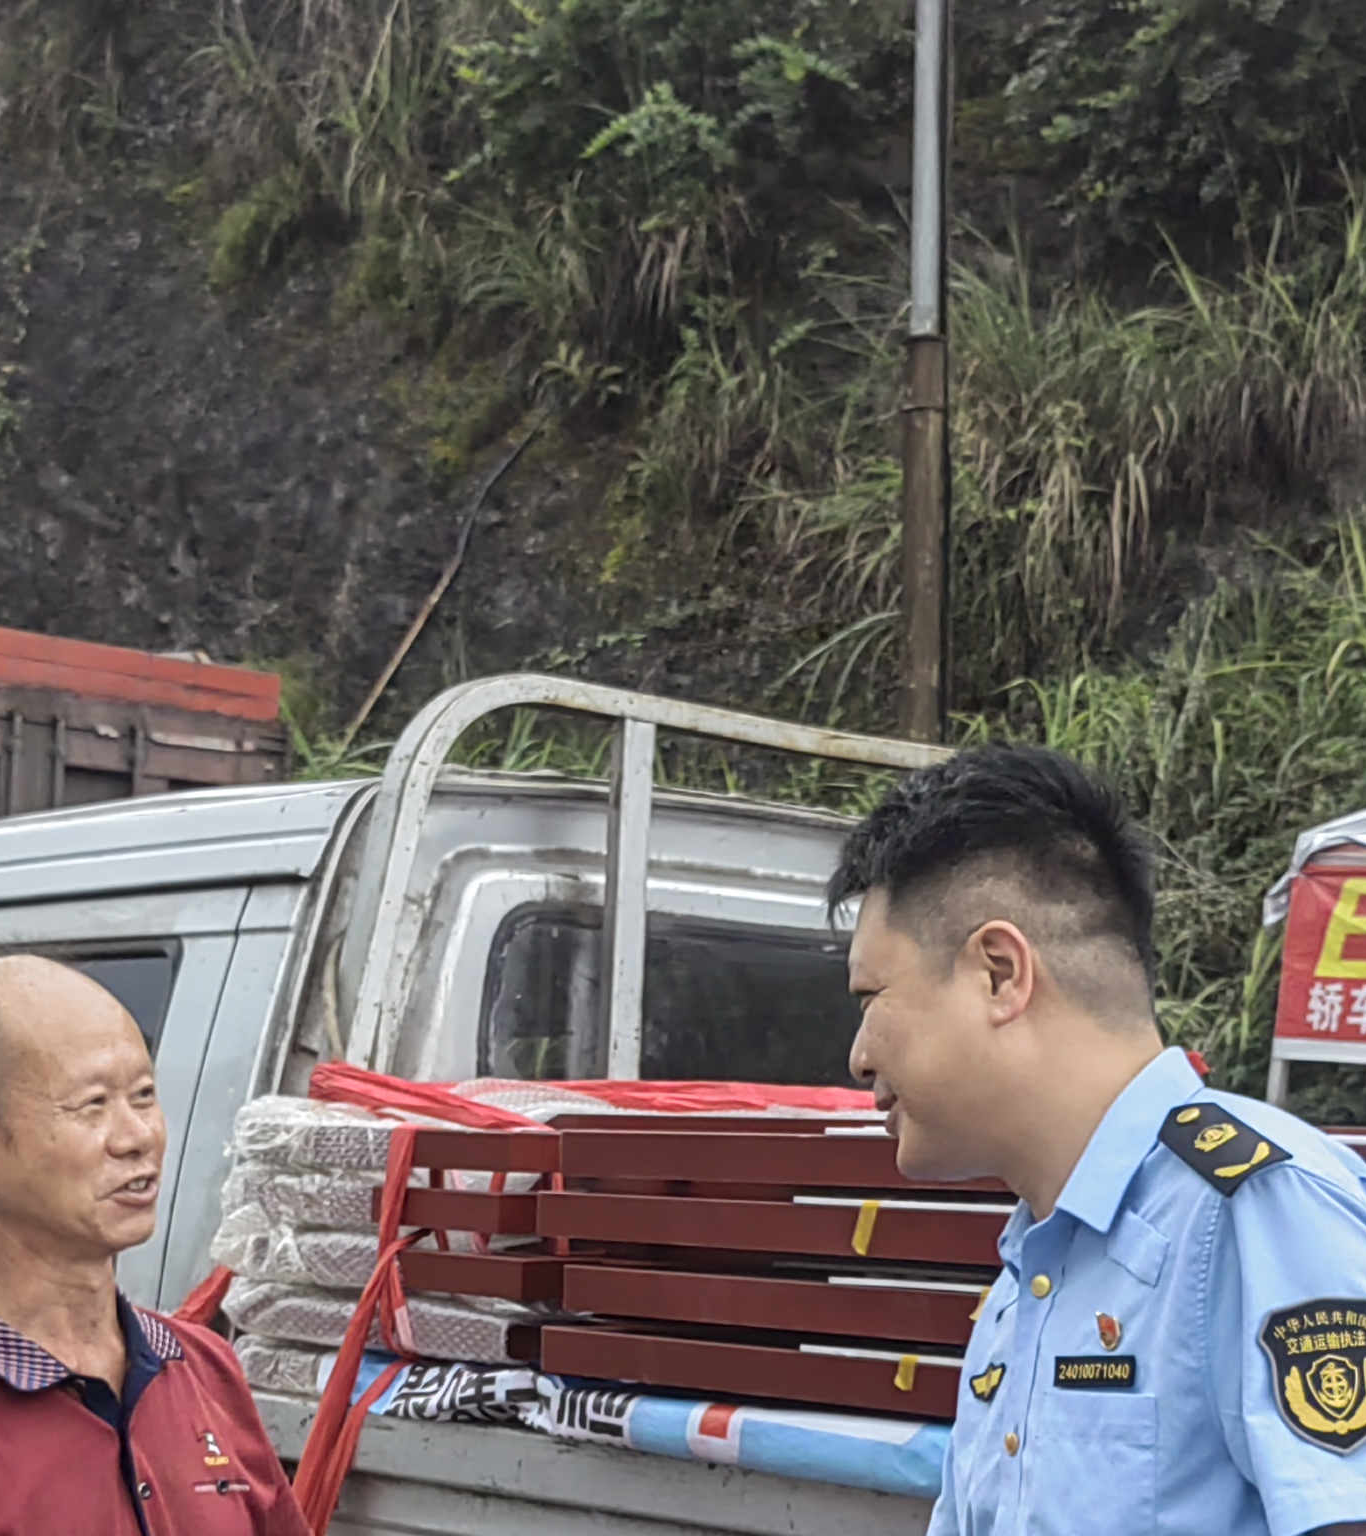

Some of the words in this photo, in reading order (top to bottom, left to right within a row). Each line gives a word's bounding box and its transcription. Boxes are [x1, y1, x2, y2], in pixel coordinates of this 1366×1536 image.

[1285, 1330, 1366, 1355] 交通运输执法
[1058, 1363, 1130, 1380] 24010071040
